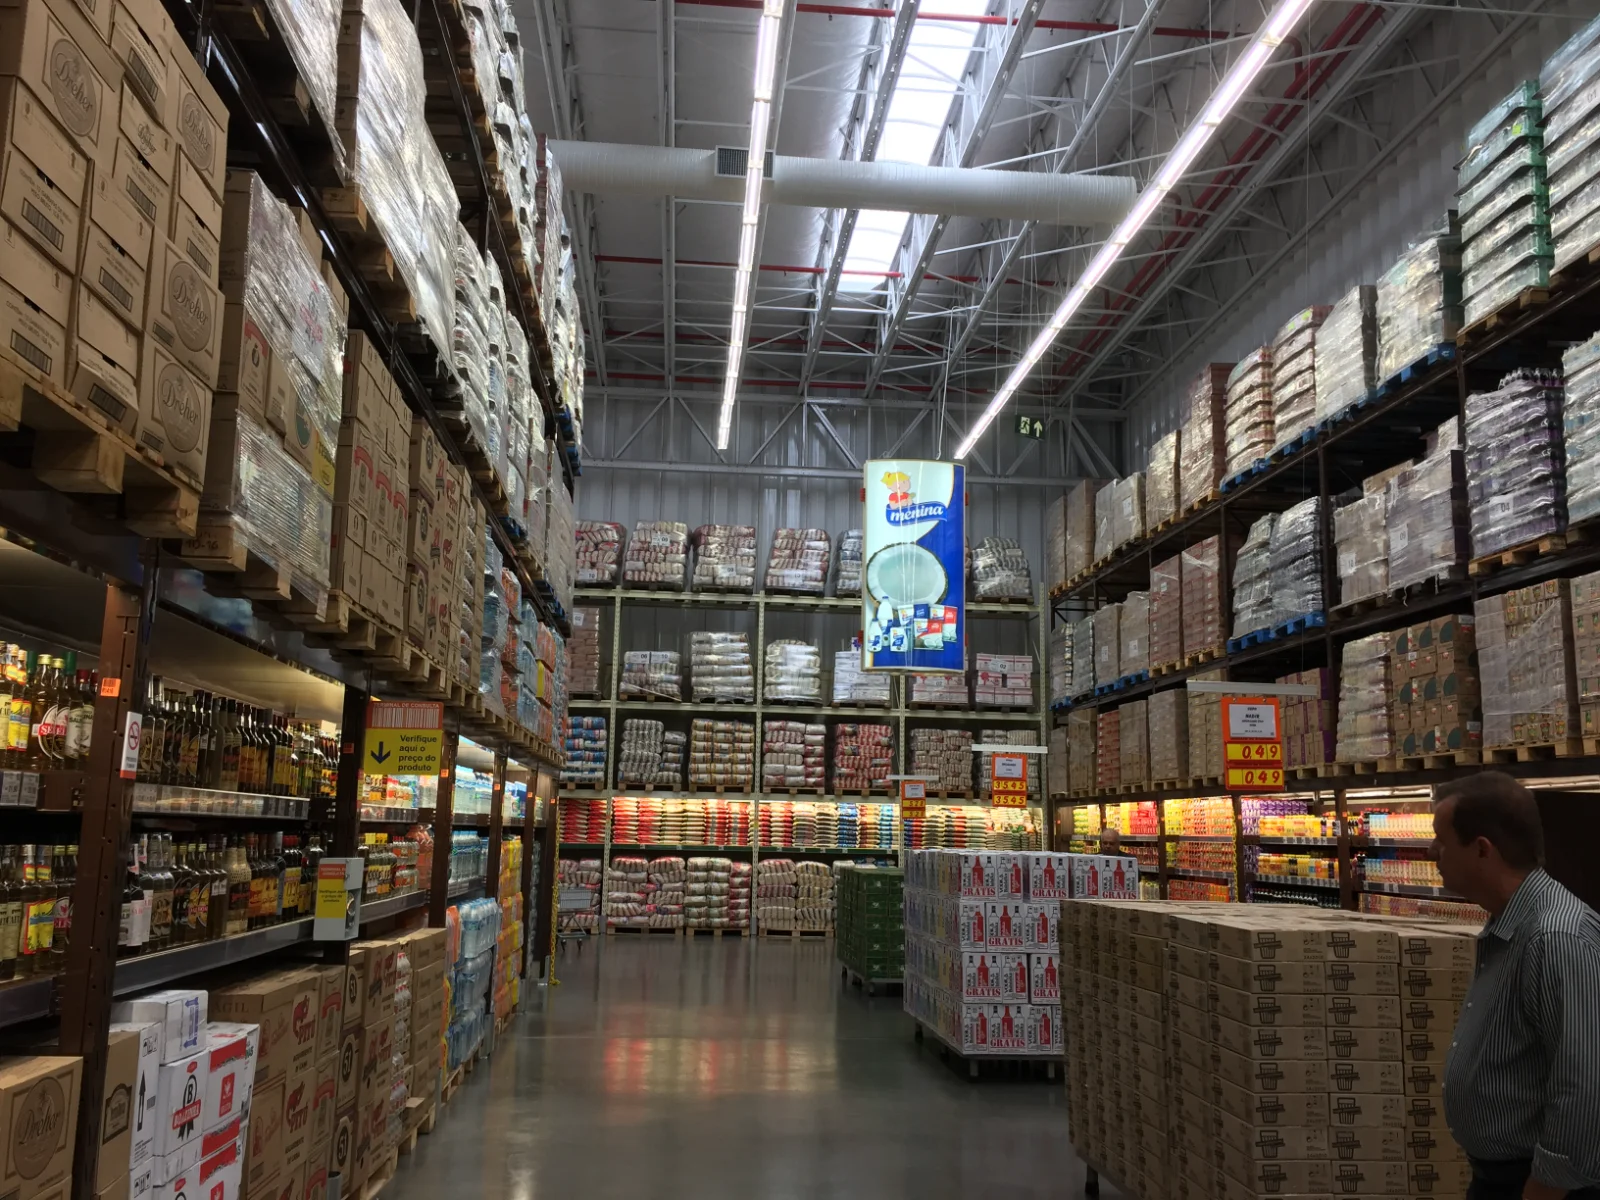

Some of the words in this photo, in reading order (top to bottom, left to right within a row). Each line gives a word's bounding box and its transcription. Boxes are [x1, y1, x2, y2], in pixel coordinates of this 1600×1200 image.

[54, 52, 95, 113] Dreher
[184, 107, 212, 152] Dreher
[172, 275, 209, 324] Dreher
[161, 378, 199, 422] Dreher
[890, 505, 944, 522] menina
[400, 734, 438, 743] Verifique
[399, 745, 418, 753] aqui
[1242, 745, 1278, 759] 0,49
[398, 755, 423, 763] preço
[398, 764, 432, 772] produto
[1244, 770, 1280, 784] 0,49
[962, 887, 996, 896] GRATIS
[1032, 888, 1067, 898] GRATIS
[1102, 890, 1137, 900] GRATIS
[987, 936, 1024, 946] GRATIS
[965, 987, 1001, 997] GRATIS
[1033, 988, 1060, 998] GRAT
[990, 1037, 1026, 1047] GRATIS
[342, 1052, 353, 1076] 51
[18, 1104, 61, 1145] Dreher
[337, 1135, 347, 1161] 51
